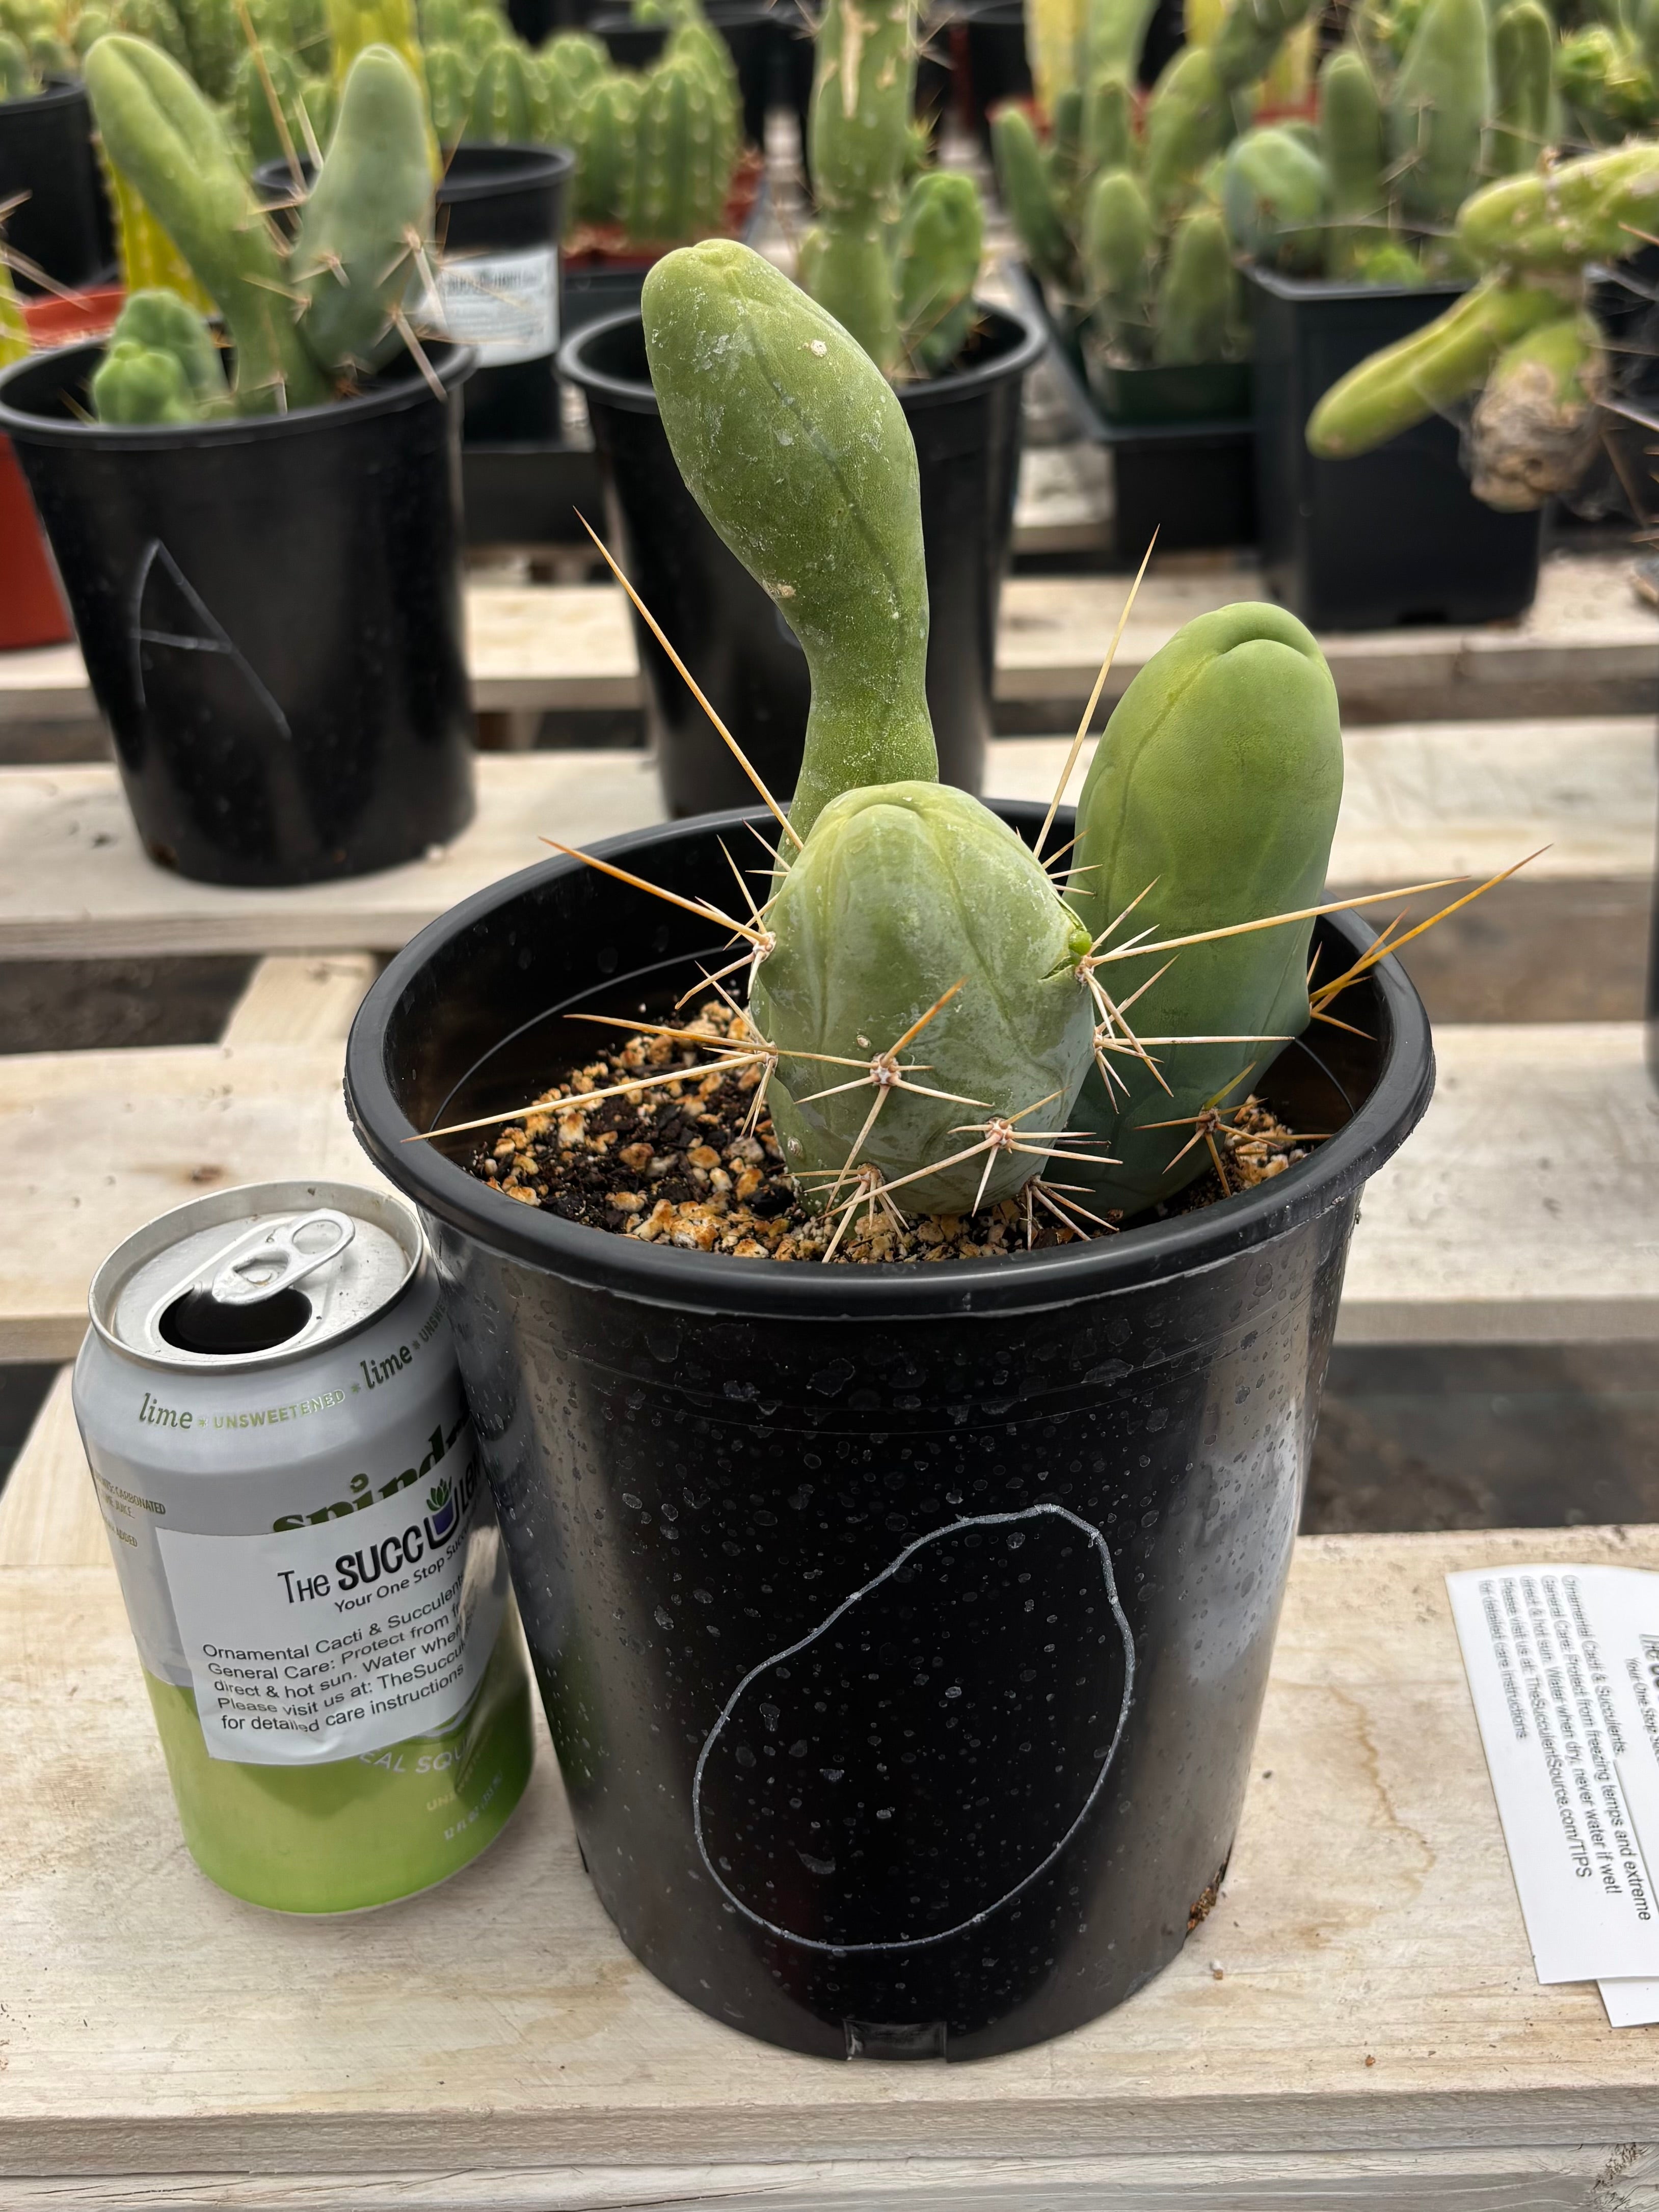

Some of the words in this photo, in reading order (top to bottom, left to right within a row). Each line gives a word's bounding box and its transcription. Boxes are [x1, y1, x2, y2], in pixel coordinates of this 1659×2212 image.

[128, 537, 293, 742] A
[139, 1392, 193, 1429] lime
[213, 1389, 345, 1429] UNSWEETENED
[360, 1345, 413, 1390] lime
[116, 1486, 166, 1515] CARBONATED
[334, 1593, 372, 1613] Your
[377, 1578, 410, 1599] One
[413, 1556, 445, 1584] Stop
[1541, 1575, 1567, 1618] General
[1561, 1575, 1595, 1638] Ornamental
[203, 1644, 309, 1660] Ornamental
[315, 1628, 363, 1653] Cacti
[369, 1623, 382, 1637] &
[208, 1662, 278, 1680] General
[284, 1660, 335, 1679] Care:
[341, 1632, 405, 1664] Protect
[410, 1614, 449, 1639] from
[1509, 1615, 1530, 1641] visit
[1532, 1618, 1549, 1639] hot
[1493, 1641, 1511, 1669] care
[1515, 1640, 1532, 1656] us
[1581, 1640, 1606, 1671] Cacti
[214, 1680, 261, 1697] direct
[266, 1685, 280, 1698] &
[284, 1683, 315, 1698] hot
[319, 1671, 358, 1691] sun.
[362, 1647, 416, 1673] Water
[1544, 1666, 1565, 1705] Water
[1563, 1653, 1592, 1697] Protect
[1590, 1672, 1608, 1683] &
[1624, 1657, 1642, 1682] Your
[218, 1697, 278, 1713] Please
[282, 1701, 319, 1716] visit
[324, 1692, 345, 1708] us
[350, 1681, 373, 1698] at:
[221, 1714, 246, 1730] for
[251, 1715, 320, 1733] detailed
[325, 1707, 365, 1726] care
[369, 1663, 464, 1715] instructions
[1501, 1669, 1529, 1740] instructions
[1576, 1698, 1594, 1728] from
[1633, 1682, 1651, 1707] One
[1556, 1704, 1574, 1739] when
[1641, 1707, 1658, 1735] Stop
[1585, 1730, 1611, 1782] freezing
[1524, 1676, 1593, 1878] TheSucculentSource.com/TIPS
[1572, 1768, 1594, 1808] never
[1601, 1784, 1624, 1827] temps
[1584, 1808, 1608, 1849] water
[1614, 1830, 1639, 1857] and
[1595, 1851, 1615, 1862] if
[1623, 1860, 1651, 1921] extreme
